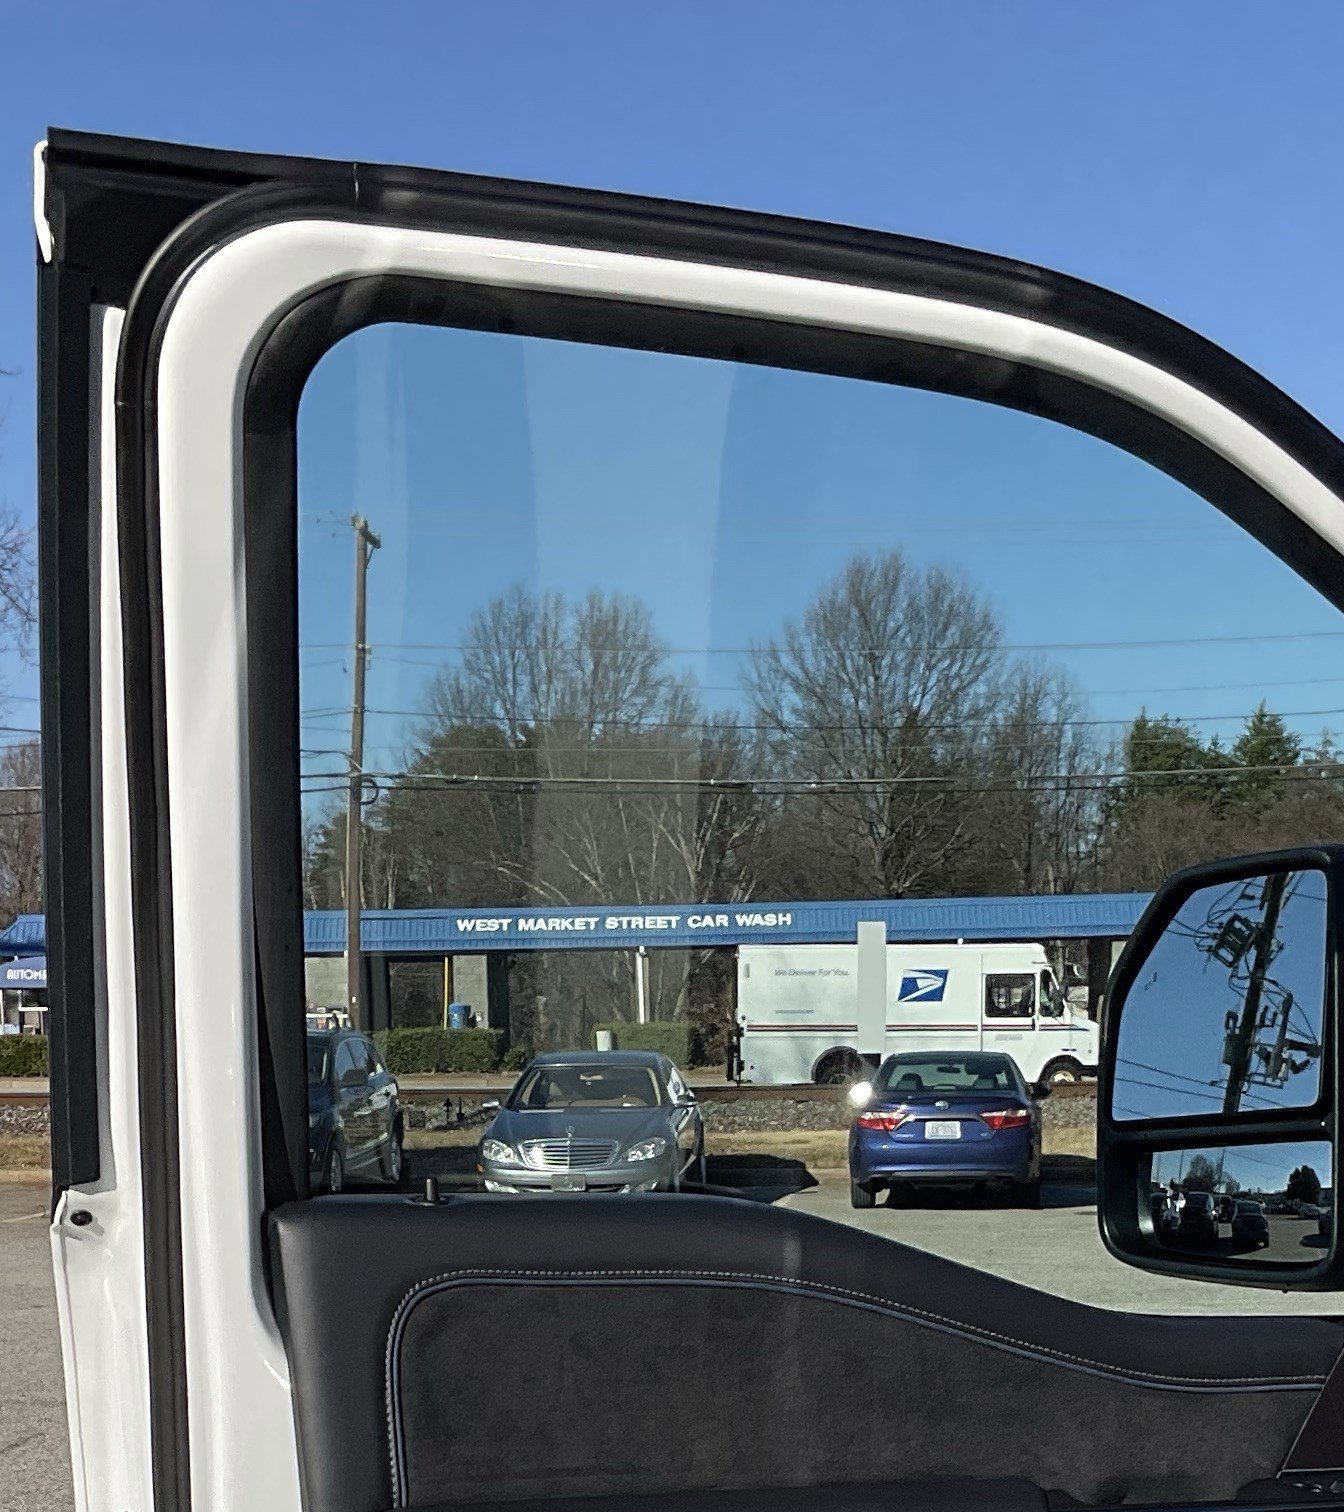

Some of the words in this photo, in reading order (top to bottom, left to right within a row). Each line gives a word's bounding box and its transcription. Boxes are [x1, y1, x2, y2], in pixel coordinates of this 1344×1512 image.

[457, 919, 512, 931] WEST
[518, 917, 599, 931] MARKET
[606, 916, 681, 930] STREET
[687, 915, 728, 928] CAR
[735, 913, 792, 927] WASH
